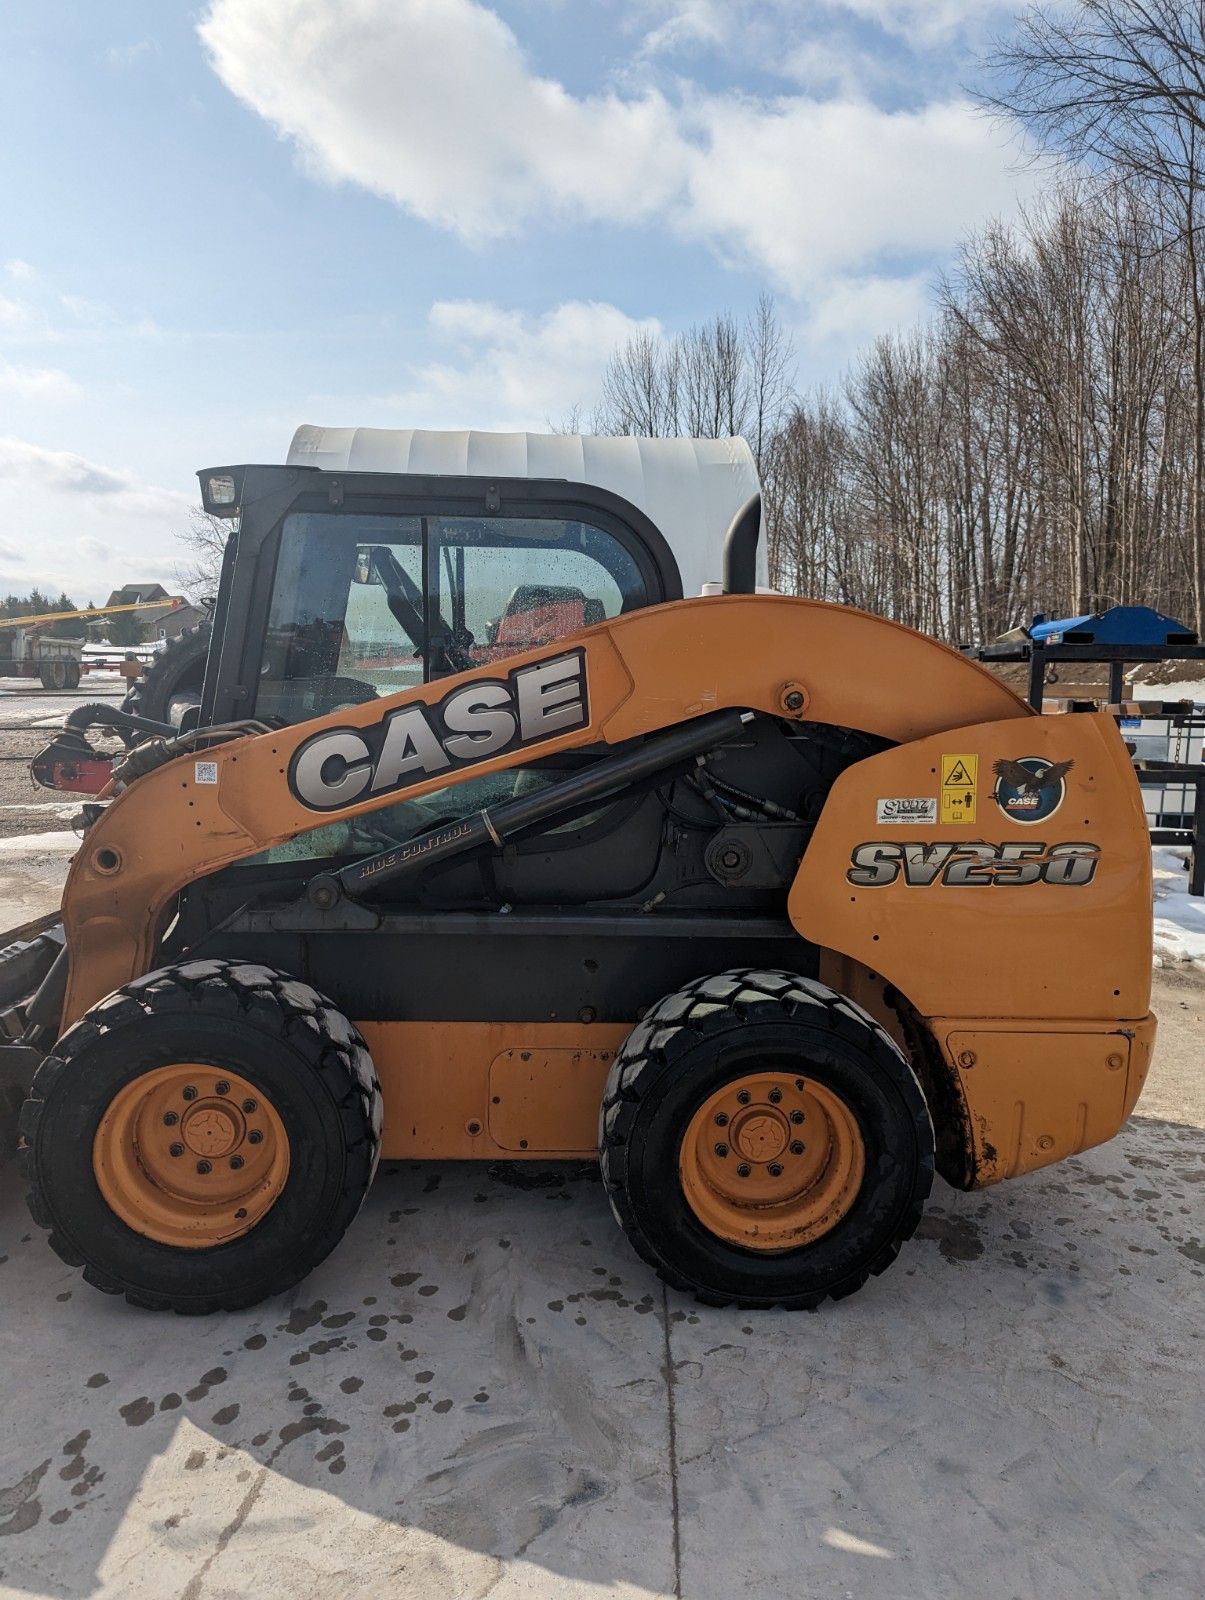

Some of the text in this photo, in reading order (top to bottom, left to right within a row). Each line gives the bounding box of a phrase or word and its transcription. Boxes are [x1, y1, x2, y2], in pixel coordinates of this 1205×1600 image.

[296, 656, 585, 806] CASE
[359, 824, 472, 879] RIDE CONTROL
[847, 842, 1101, 887] SV250
